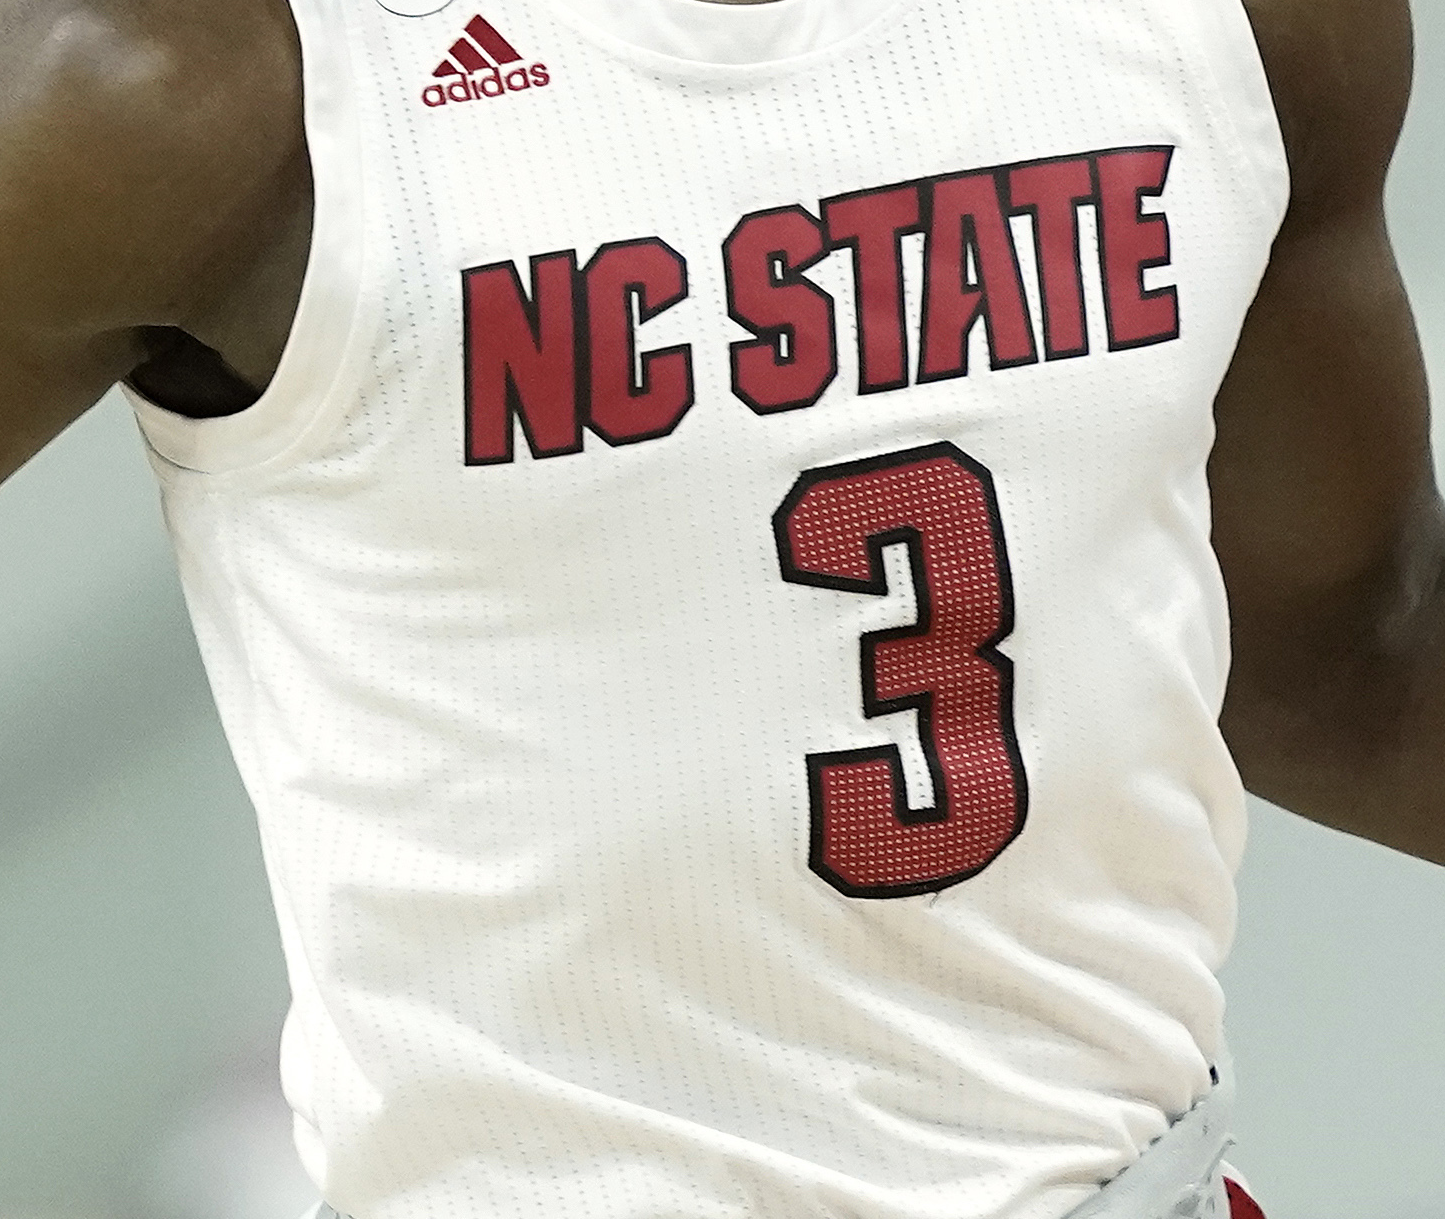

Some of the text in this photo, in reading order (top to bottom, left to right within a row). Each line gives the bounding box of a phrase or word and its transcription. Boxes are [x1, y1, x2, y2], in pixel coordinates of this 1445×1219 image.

[422, 63, 550, 107] adidas
[461, 145, 1180, 466] NC STATE
[771, 441, 1029, 898] 3
